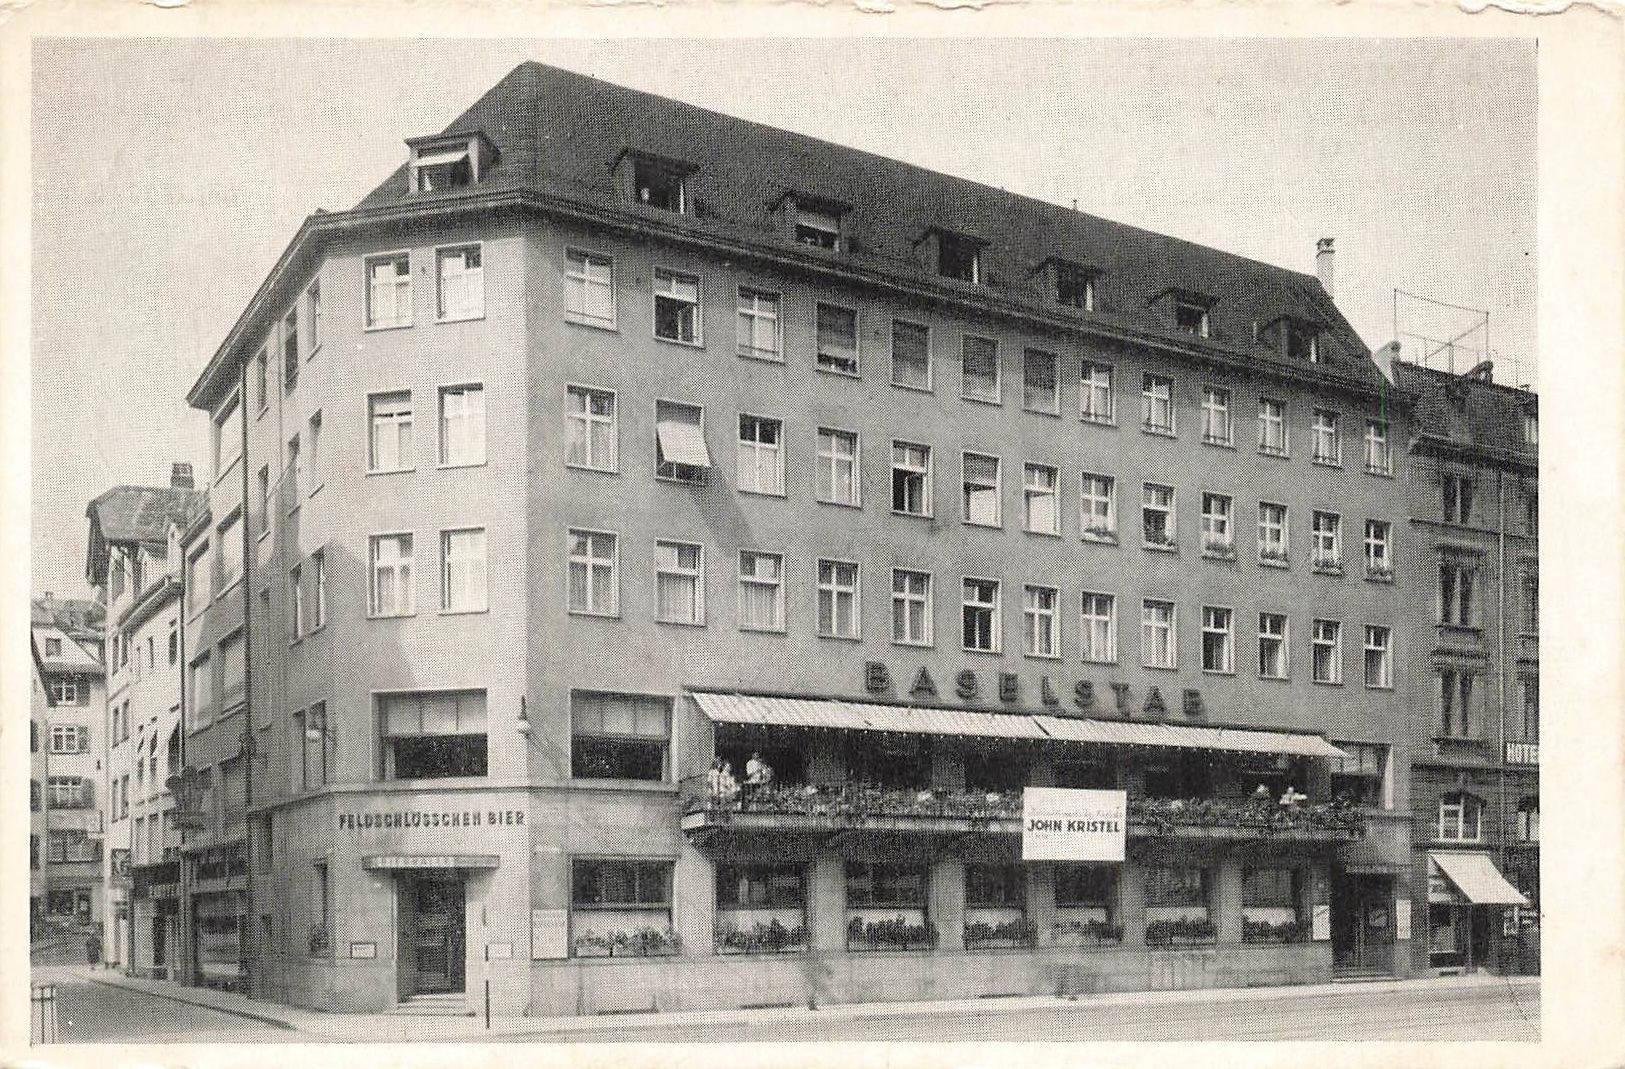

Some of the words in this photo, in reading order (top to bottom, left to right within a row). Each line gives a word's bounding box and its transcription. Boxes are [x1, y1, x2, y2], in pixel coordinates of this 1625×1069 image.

[863, 660, 1205, 717] BASELSTAB
[488, 810, 525, 827] BIER
[1027, 819, 1062, 832] JOHN
[1067, 820, 1121, 832] KRISTEL
